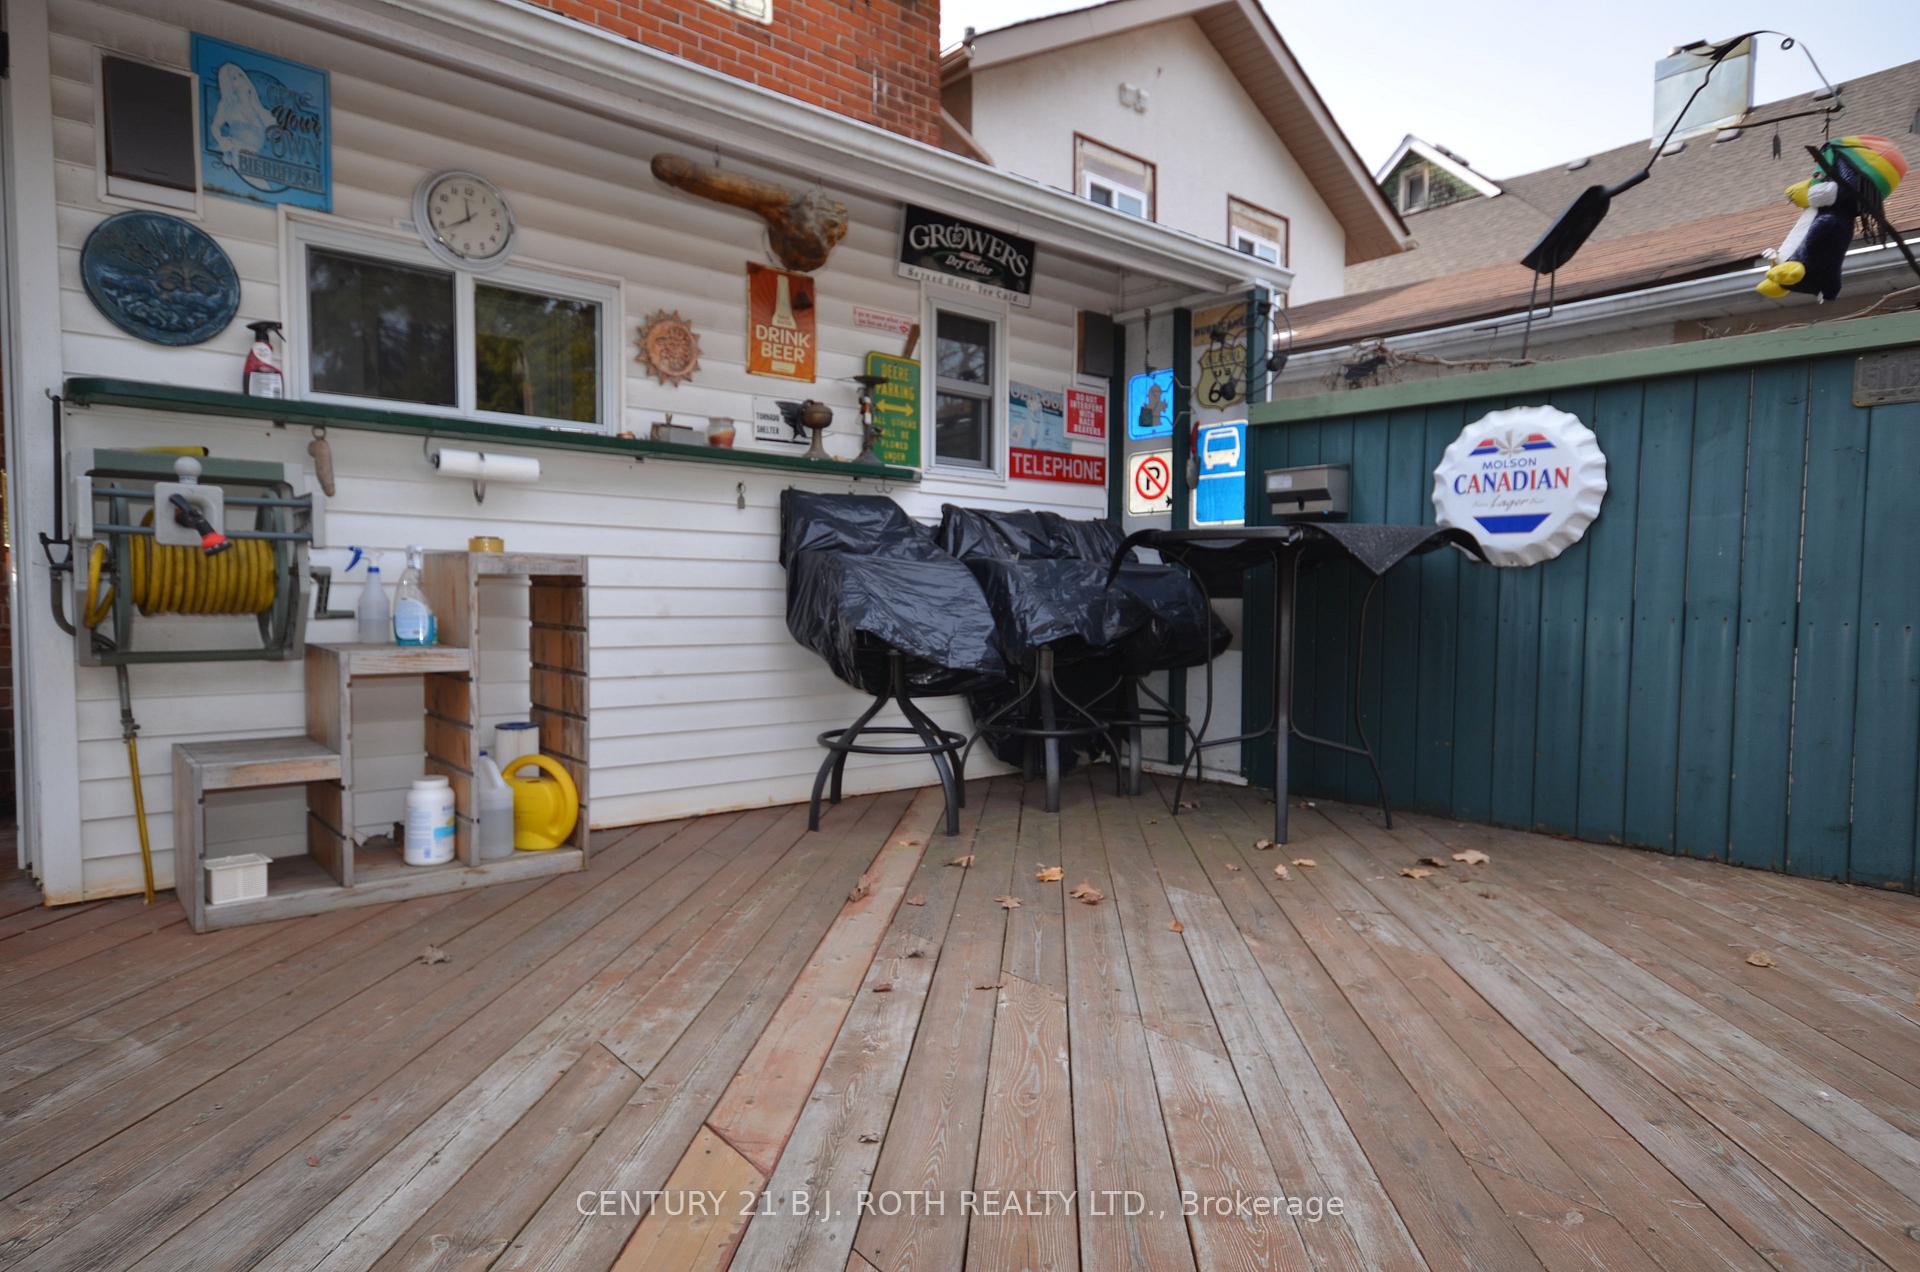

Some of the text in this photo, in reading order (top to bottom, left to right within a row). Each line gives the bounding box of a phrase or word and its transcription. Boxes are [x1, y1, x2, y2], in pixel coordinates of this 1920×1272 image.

[909, 222, 1029, 277] GROWERS
[945, 254, 963, 270] Dry
[965, 260, 993, 276] Cider
[755, 324, 811, 348] DRINK
[761, 341, 805, 364] BEER
[876, 383, 915, 400] PARKING
[1070, 400, 1103, 413] INTERFERE
[1011, 452, 1103, 480] TELEPHONE
[1482, 457, 1537, 470] MOLSON
[1454, 466, 1570, 495] CANADIAN
